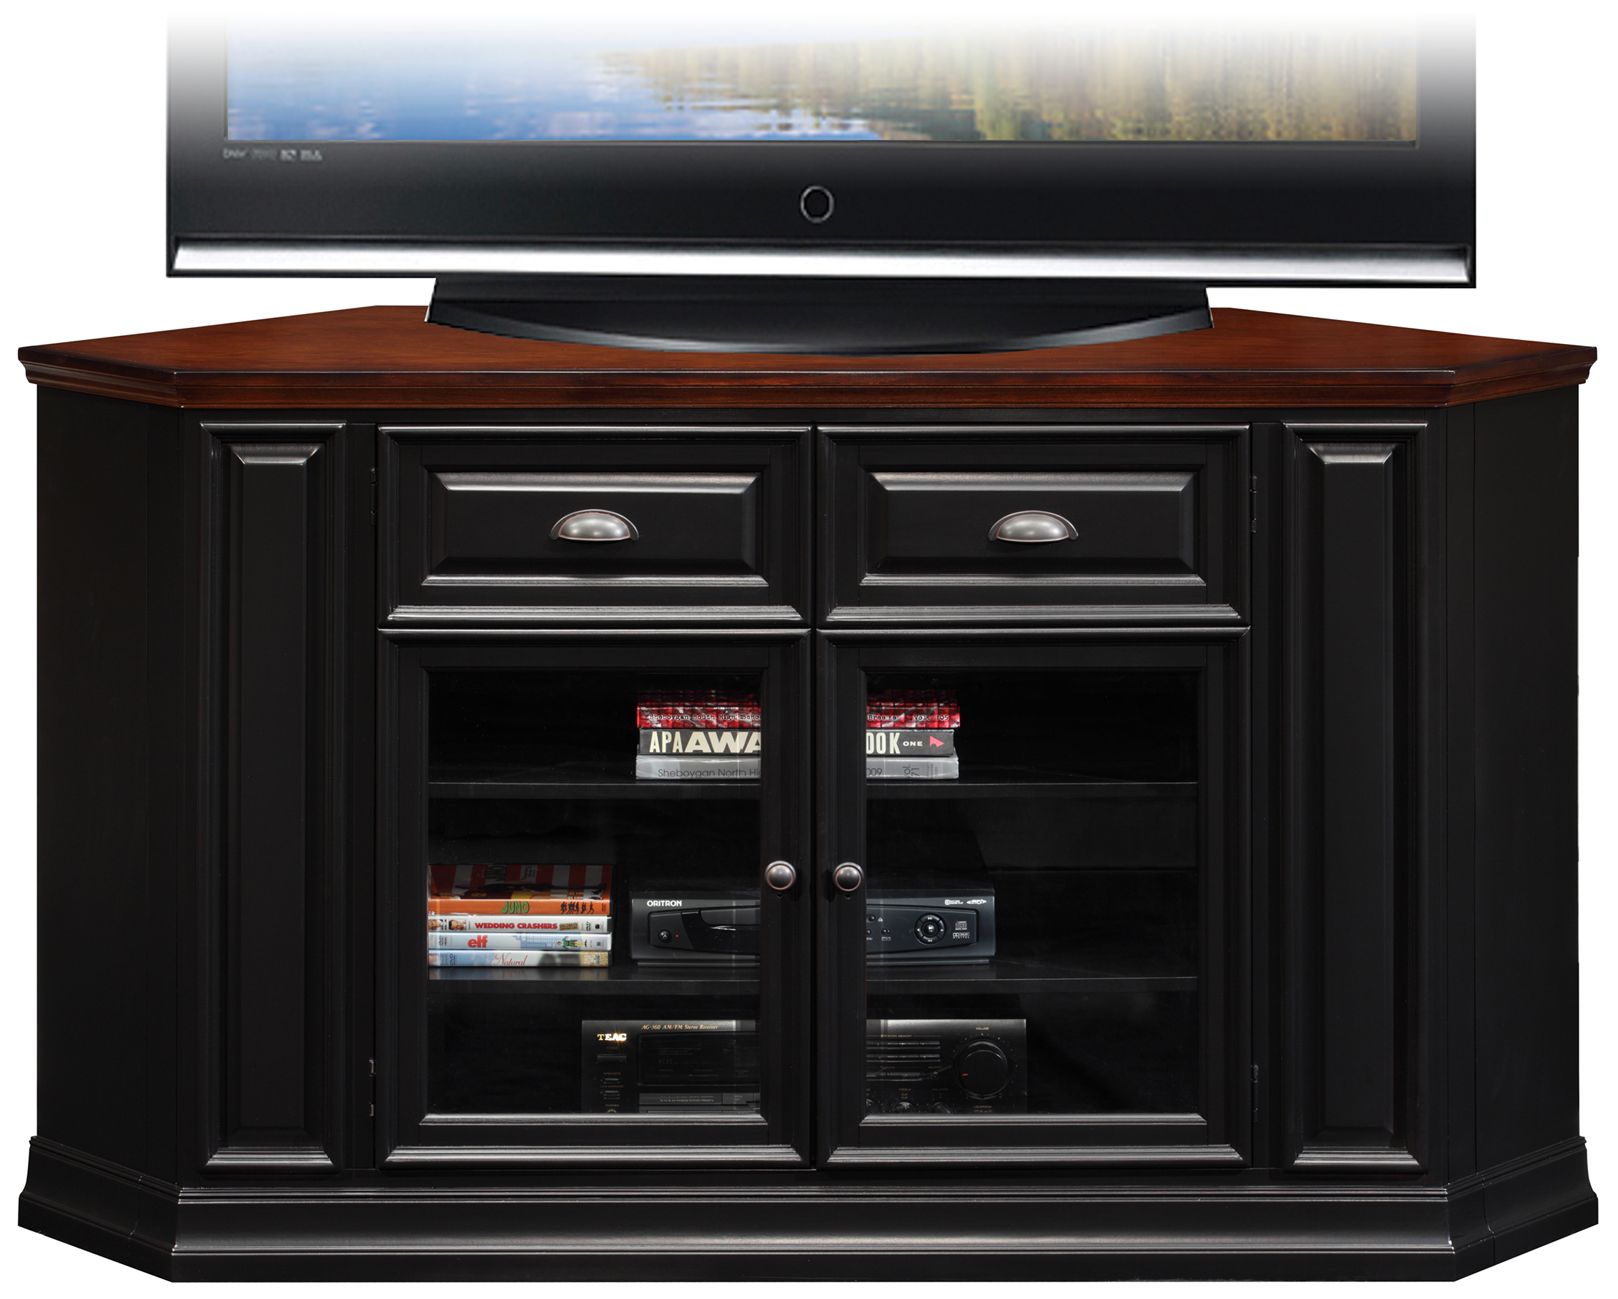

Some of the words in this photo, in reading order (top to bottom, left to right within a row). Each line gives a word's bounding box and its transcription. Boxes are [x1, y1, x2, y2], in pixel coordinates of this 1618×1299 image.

[718, 768, 746, 777] North
[502, 901, 530, 914] JUNO
[475, 922, 515, 930] WEDDING
[517, 922, 558, 930] CRASHERS
[467, 935, 488, 949] elf
[597, 1033, 627, 1042] TEAC
